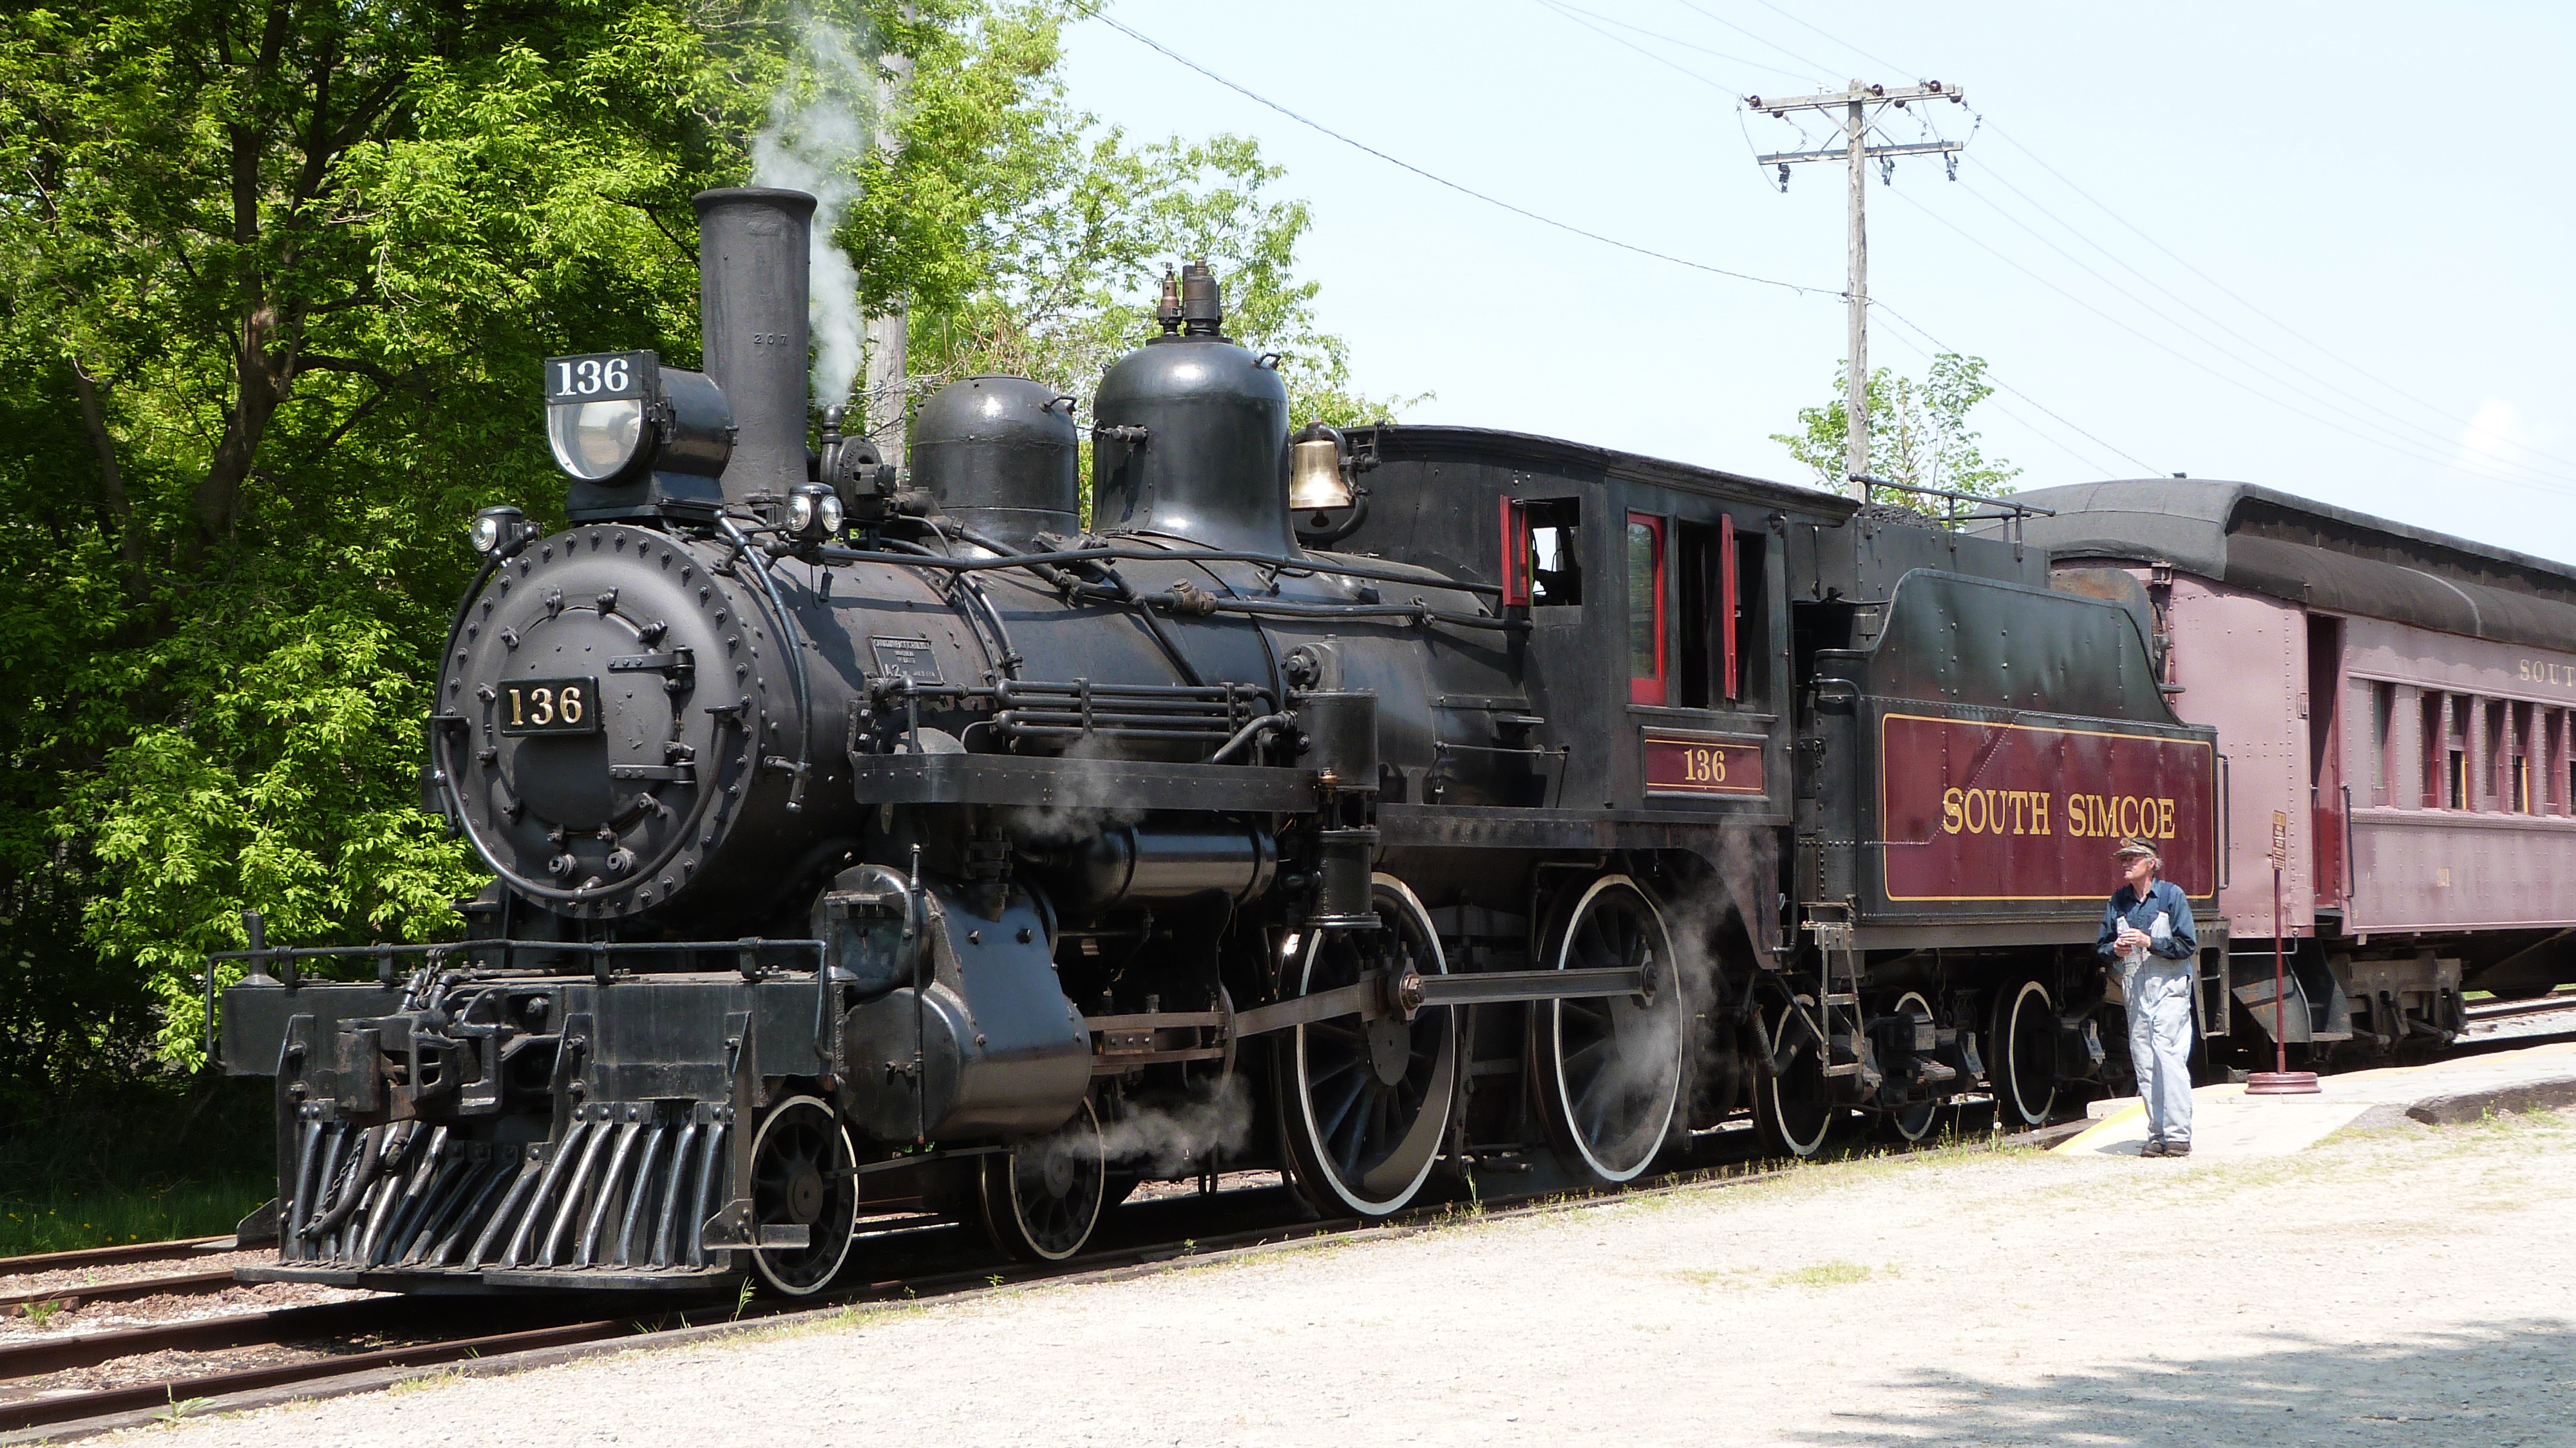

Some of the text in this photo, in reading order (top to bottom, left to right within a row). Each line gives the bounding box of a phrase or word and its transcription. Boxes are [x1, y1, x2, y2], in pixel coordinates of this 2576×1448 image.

[753, 332, 788, 346] 207
[556, 358, 629, 395] 136
[509, 687, 582, 725] 136
[1684, 748, 1726, 781] 136
[1944, 787, 2175, 839] SOUTH SIMCOE
